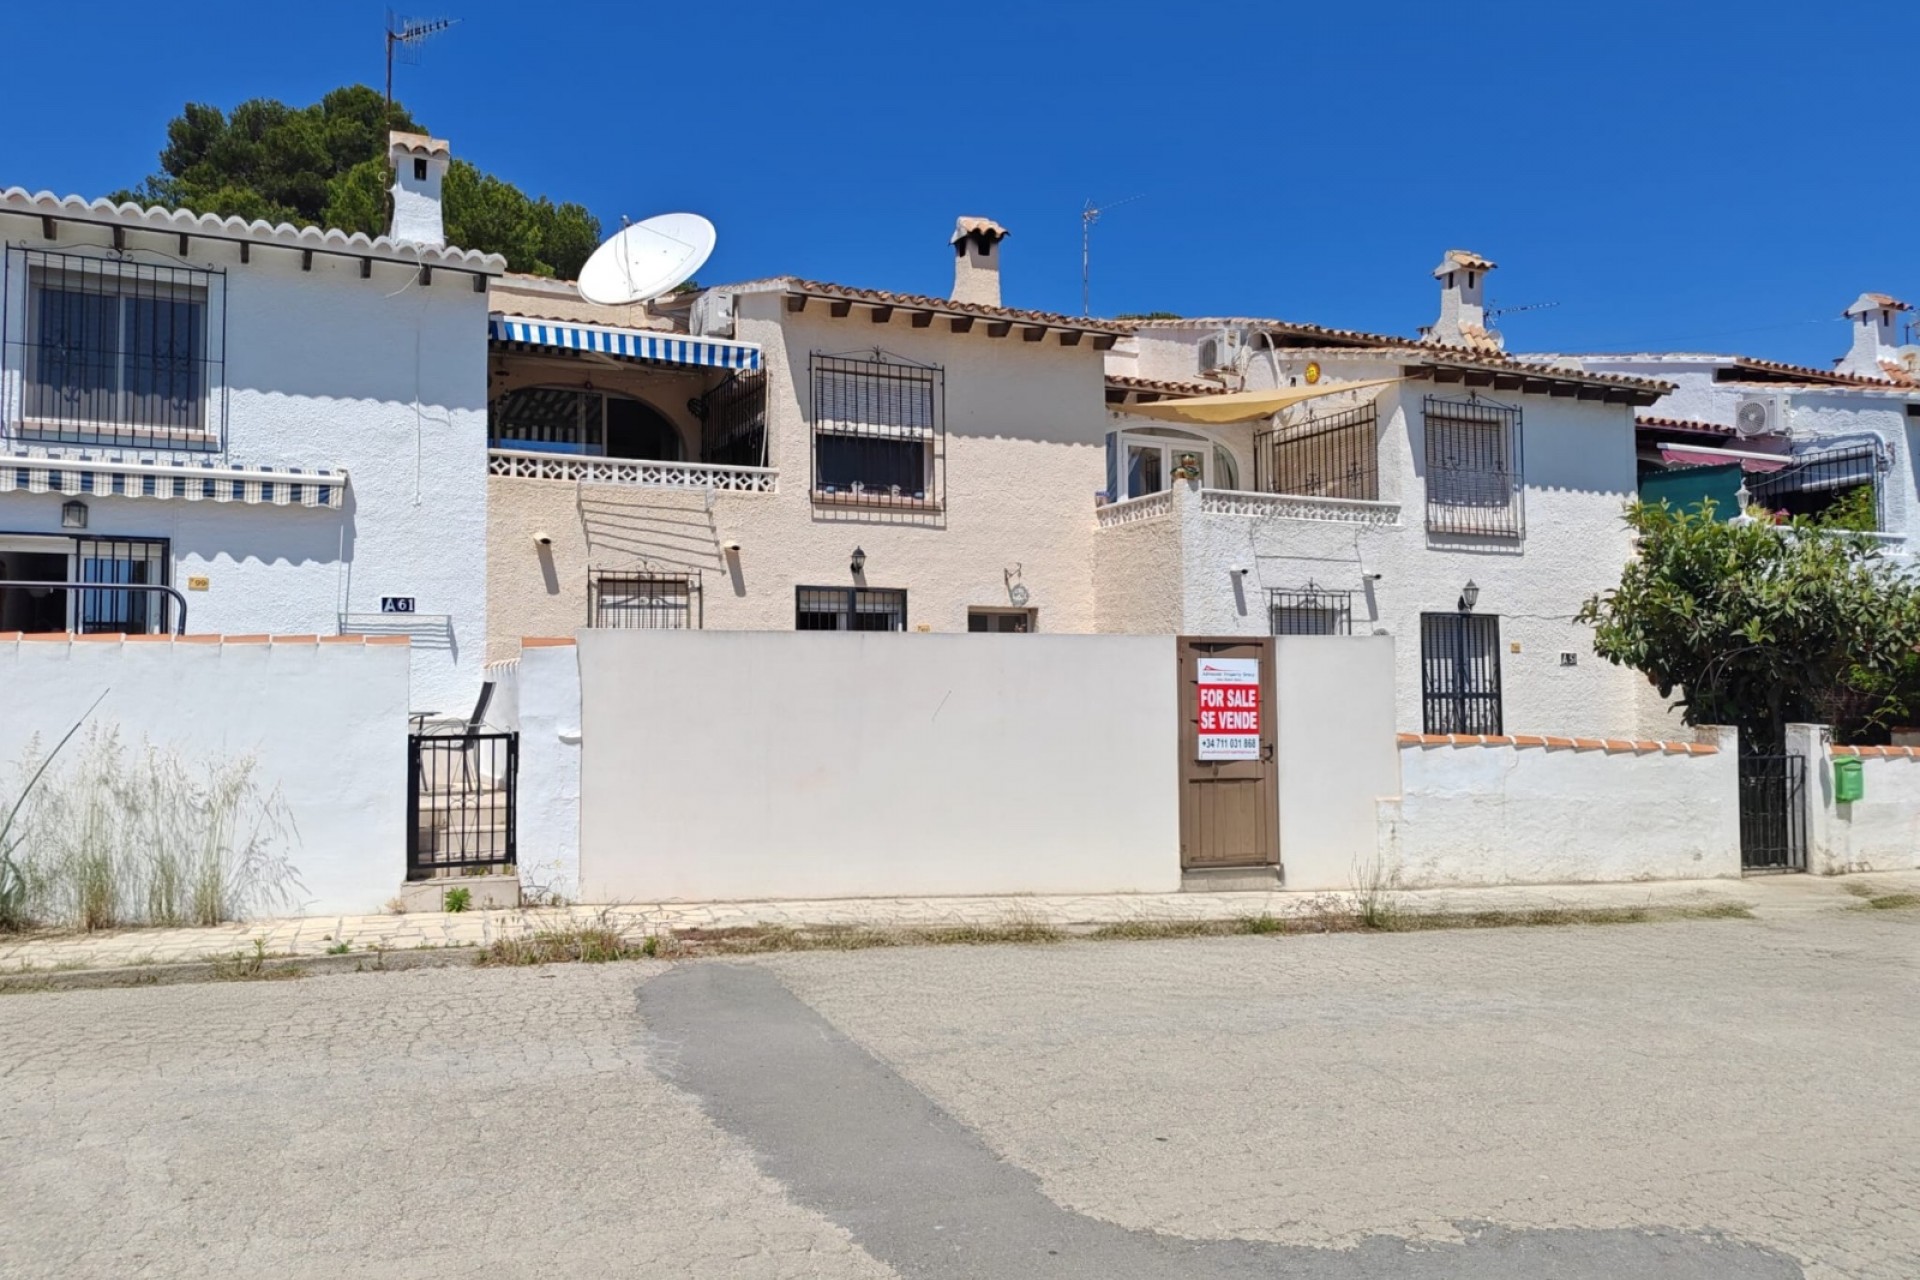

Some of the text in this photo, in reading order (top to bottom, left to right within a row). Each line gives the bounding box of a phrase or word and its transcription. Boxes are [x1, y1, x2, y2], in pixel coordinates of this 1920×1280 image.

[1200, 689, 1256, 707] FOR SALE
[1200, 711, 1257, 729] SE VENDE
[1202, 738, 1215, 748] +34
[1216, 738, 1228, 748] 711
